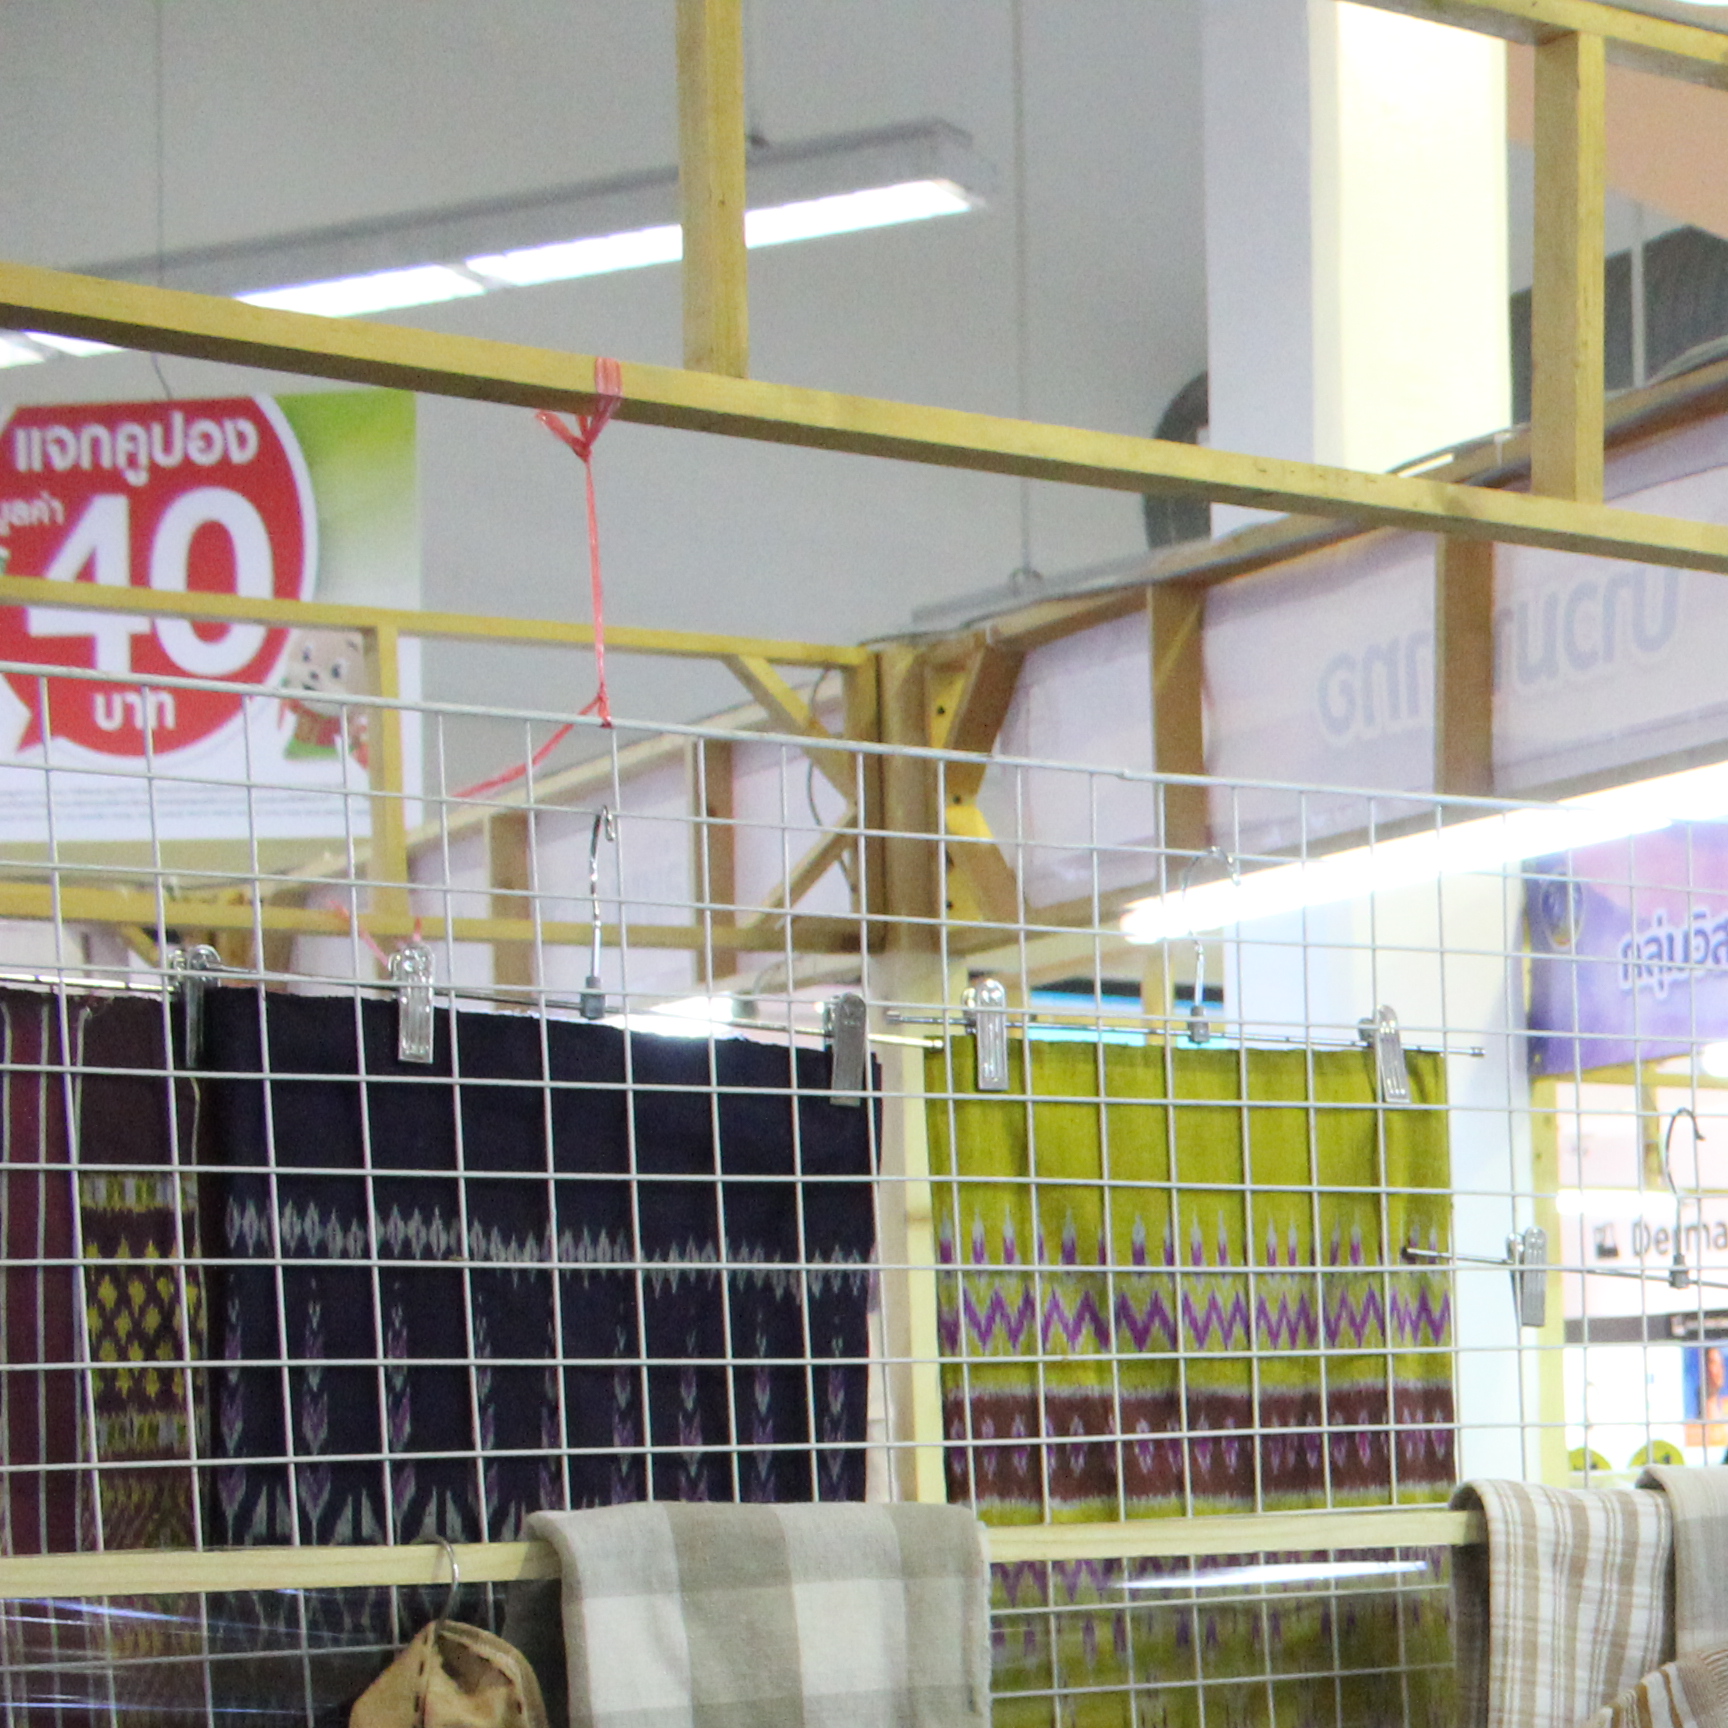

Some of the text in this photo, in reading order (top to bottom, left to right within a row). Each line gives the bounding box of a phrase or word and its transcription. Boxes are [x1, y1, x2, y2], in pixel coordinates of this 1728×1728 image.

[15, 411, 260, 486] แจกคูปอง
[29, 486, 274, 679] 40
[93, 690, 175, 732] บาท
[1632, 1220, 1728, 1257] Dema
